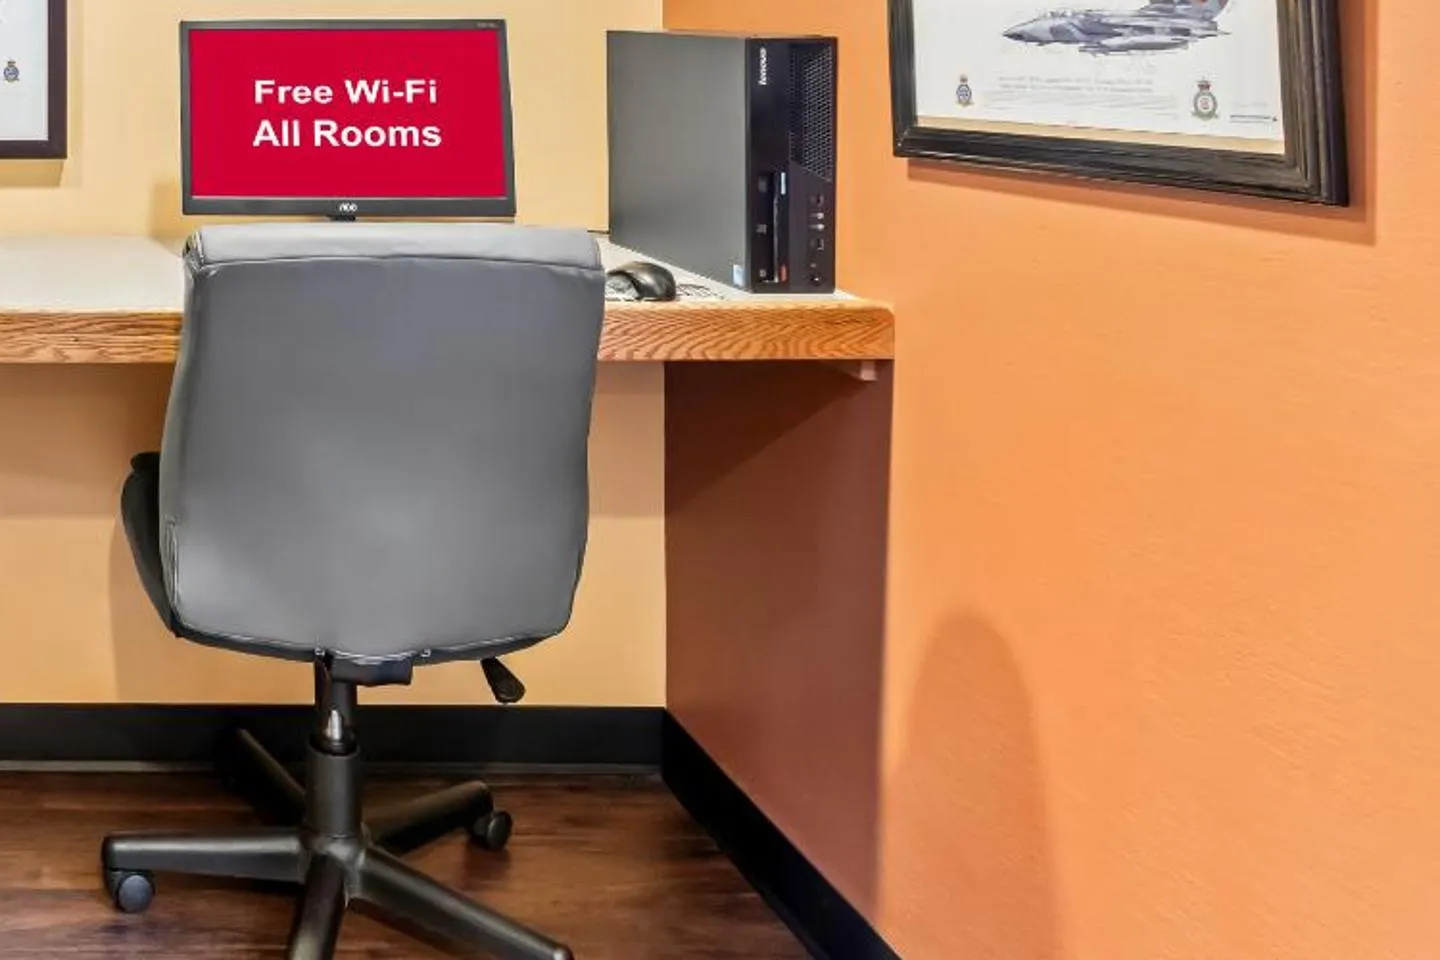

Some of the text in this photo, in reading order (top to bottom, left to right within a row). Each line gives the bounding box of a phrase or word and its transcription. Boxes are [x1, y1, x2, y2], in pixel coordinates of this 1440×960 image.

[254, 79, 437, 104] Free Wi-Fi
[252, 119, 442, 147] All Rooms
